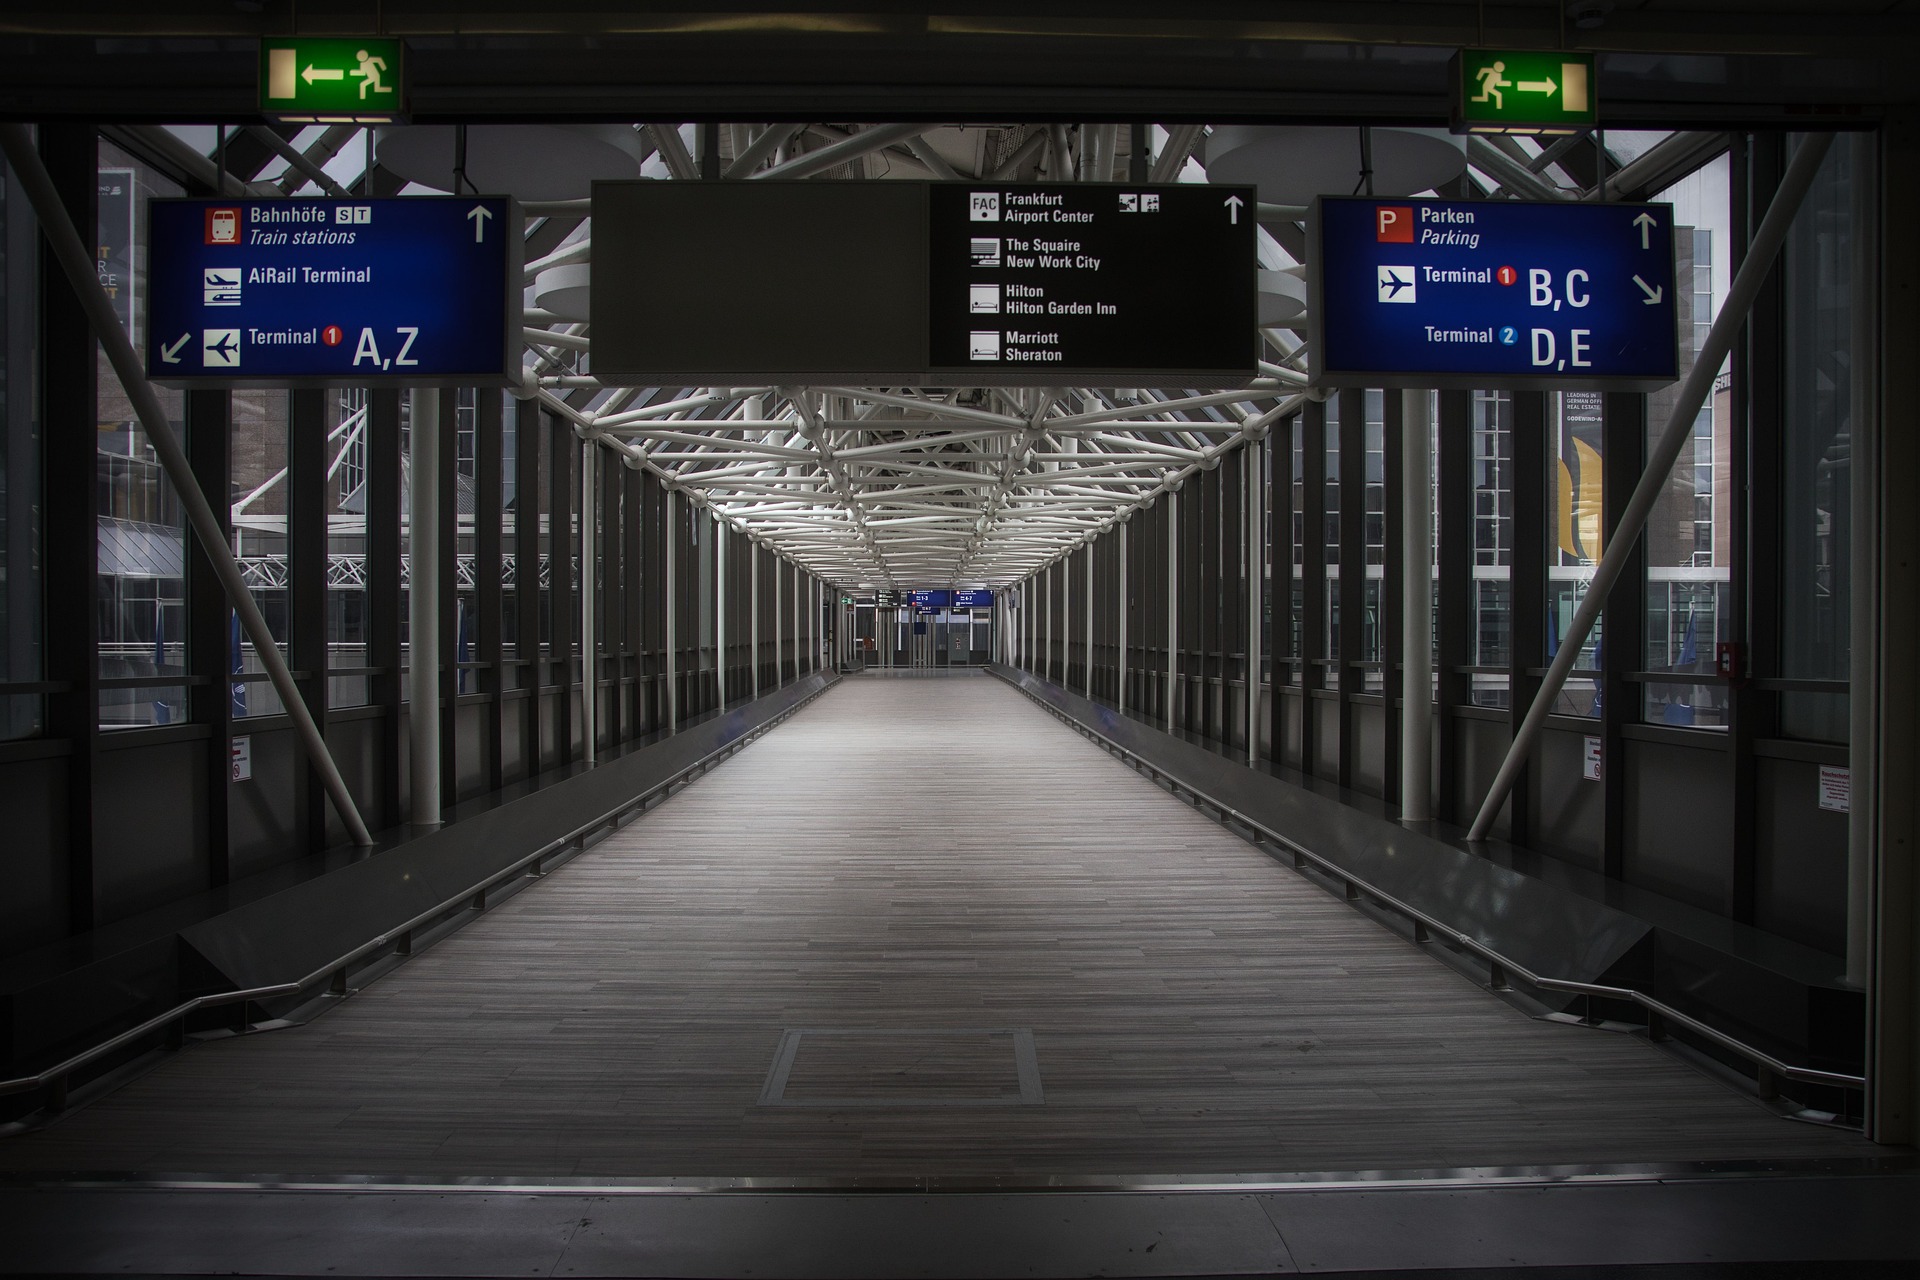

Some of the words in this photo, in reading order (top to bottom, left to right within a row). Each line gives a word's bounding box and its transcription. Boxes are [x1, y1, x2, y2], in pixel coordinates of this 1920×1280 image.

[973, 198, 997, 210] FAC
[1005, 193, 1063, 206] Frankfurt
[249, 206, 326, 223] Bahnhöfe
[1005, 209, 1050, 224] Airport
[1053, 209, 1095, 223] Center
[1379, 210, 1397, 234] P
[1421, 207, 1475, 224] Parken
[249, 229, 288, 245] Train
[292, 229, 357, 245] stations
[1420, 229, 1481, 250] Parking
[1006, 239, 1029, 252] The
[1032, 238, 1081, 254] Squaire
[1006, 256, 1035, 269] New
[1038, 255, 1072, 269] Work
[1075, 255, 1101, 272] City
[248, 267, 297, 284] AiRail
[302, 266, 371, 284] Terminal
[1006, 285, 1044, 298] Hilton
[1423, 266, 1491, 284] Terminal
[1528, 268, 1591, 312] B,C
[1006, 302, 1044, 315] Hilton
[1047, 302, 1093, 315] Garden
[1096, 302, 1117, 315] Inn
[1006, 331, 1059, 345] Marriott
[248, 327, 317, 345] Terminal
[352, 326, 420, 372] A,Z
[1005, 348, 1063, 362] Sheraton
[1424, 326, 1493, 344] Terminal
[1530, 328, 1592, 373] D,E
